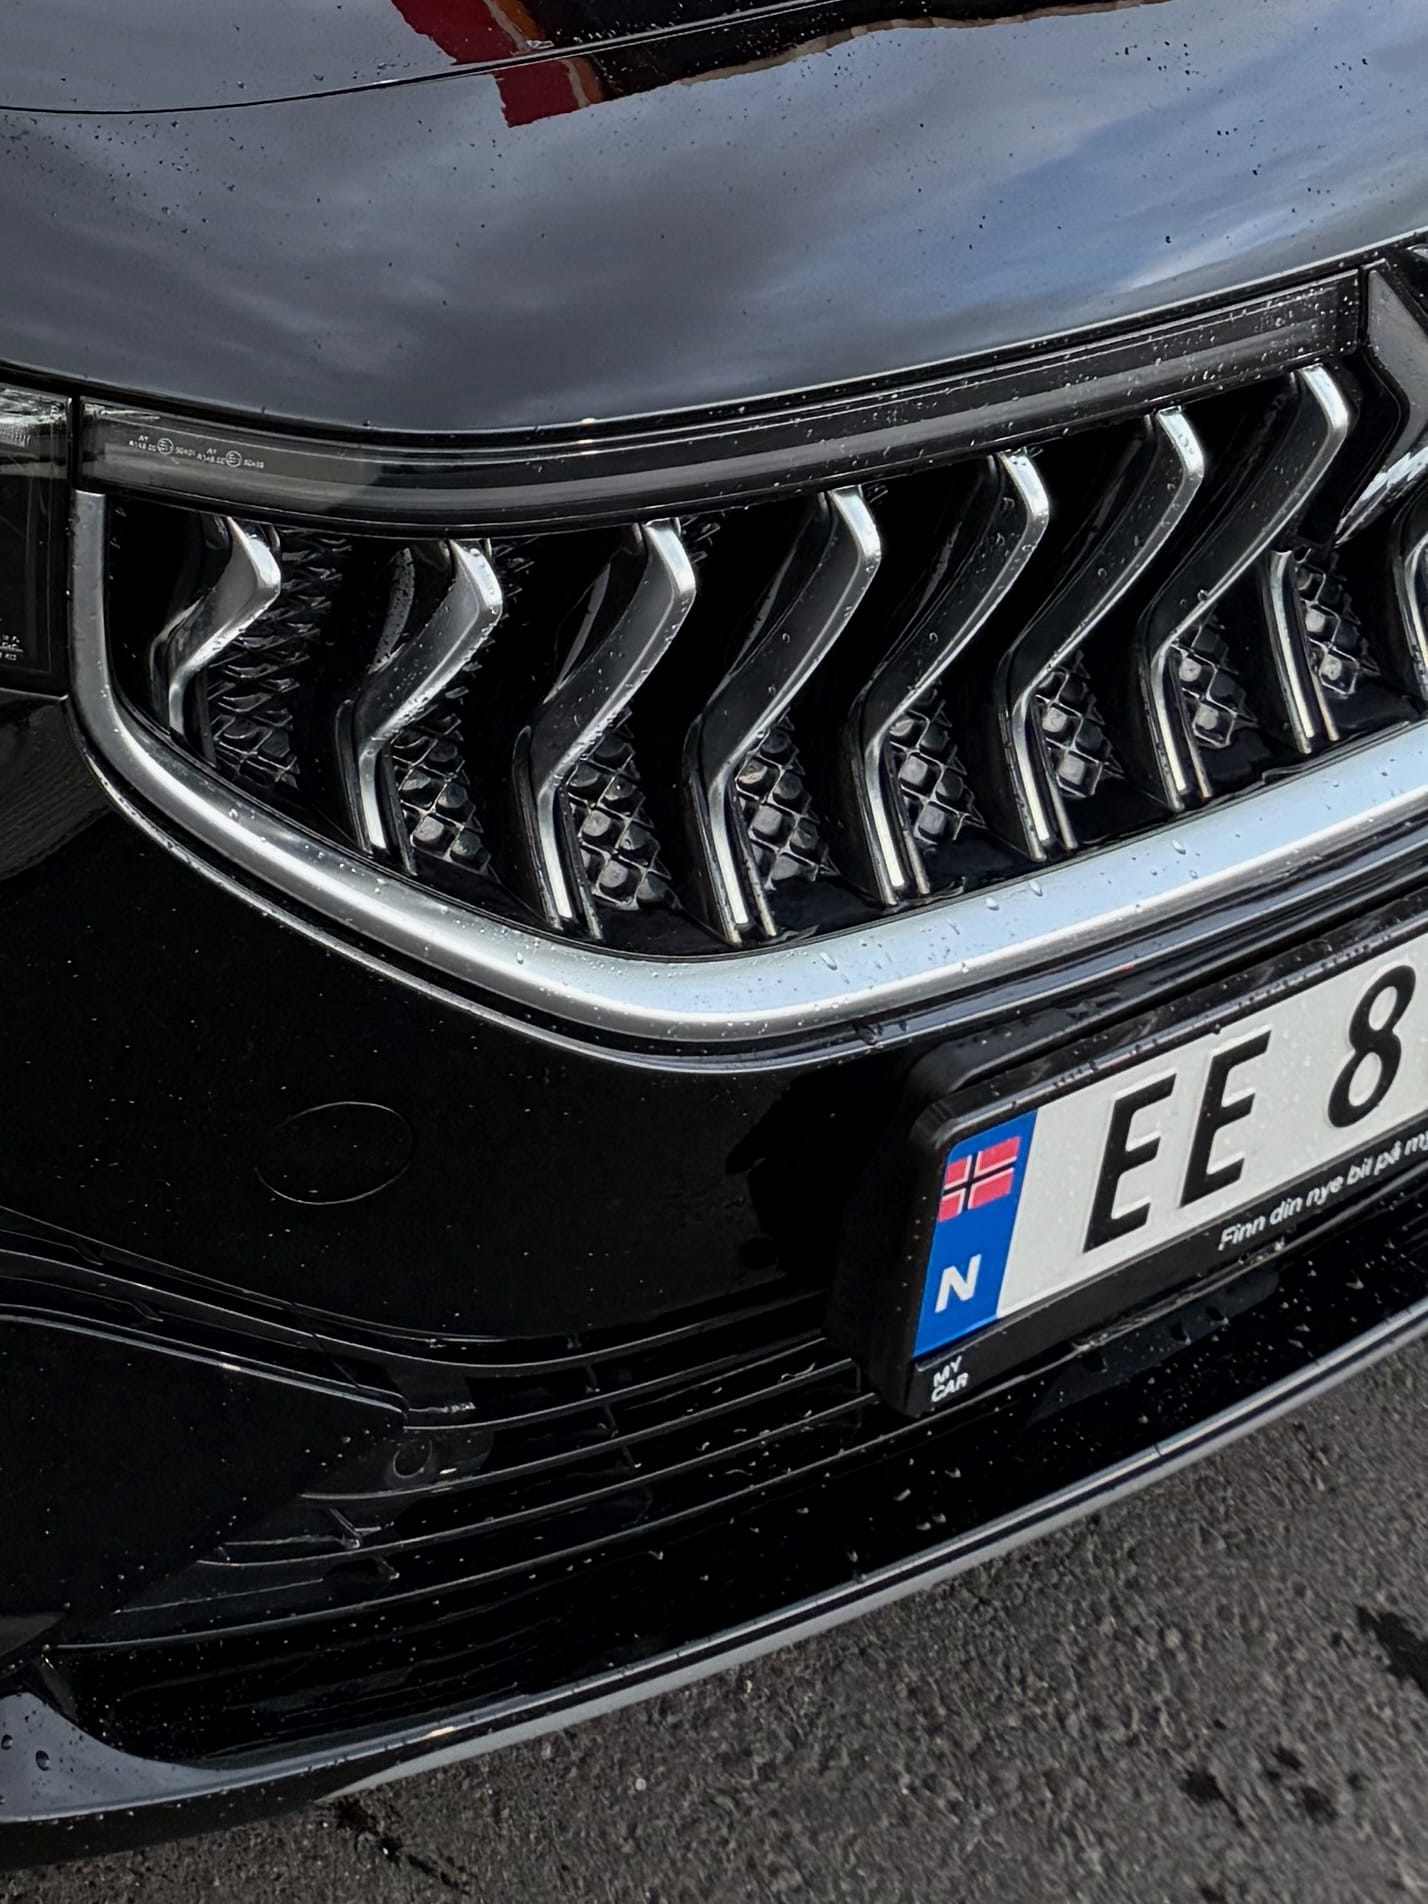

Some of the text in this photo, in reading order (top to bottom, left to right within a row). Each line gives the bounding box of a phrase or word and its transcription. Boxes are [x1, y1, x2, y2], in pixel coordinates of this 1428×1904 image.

[1082, 963, 1417, 1254] EE 8
[1218, 1214, 1266, 1251] Finn
[1269, 1196, 1304, 1226] din
[1305, 1175, 1344, 1207] nye
[1346, 1156, 1373, 1185] bil
[934, 1253, 983, 1313] N
[931, 1372, 969, 1403] CAR
[933, 1354, 963, 1388] MY
